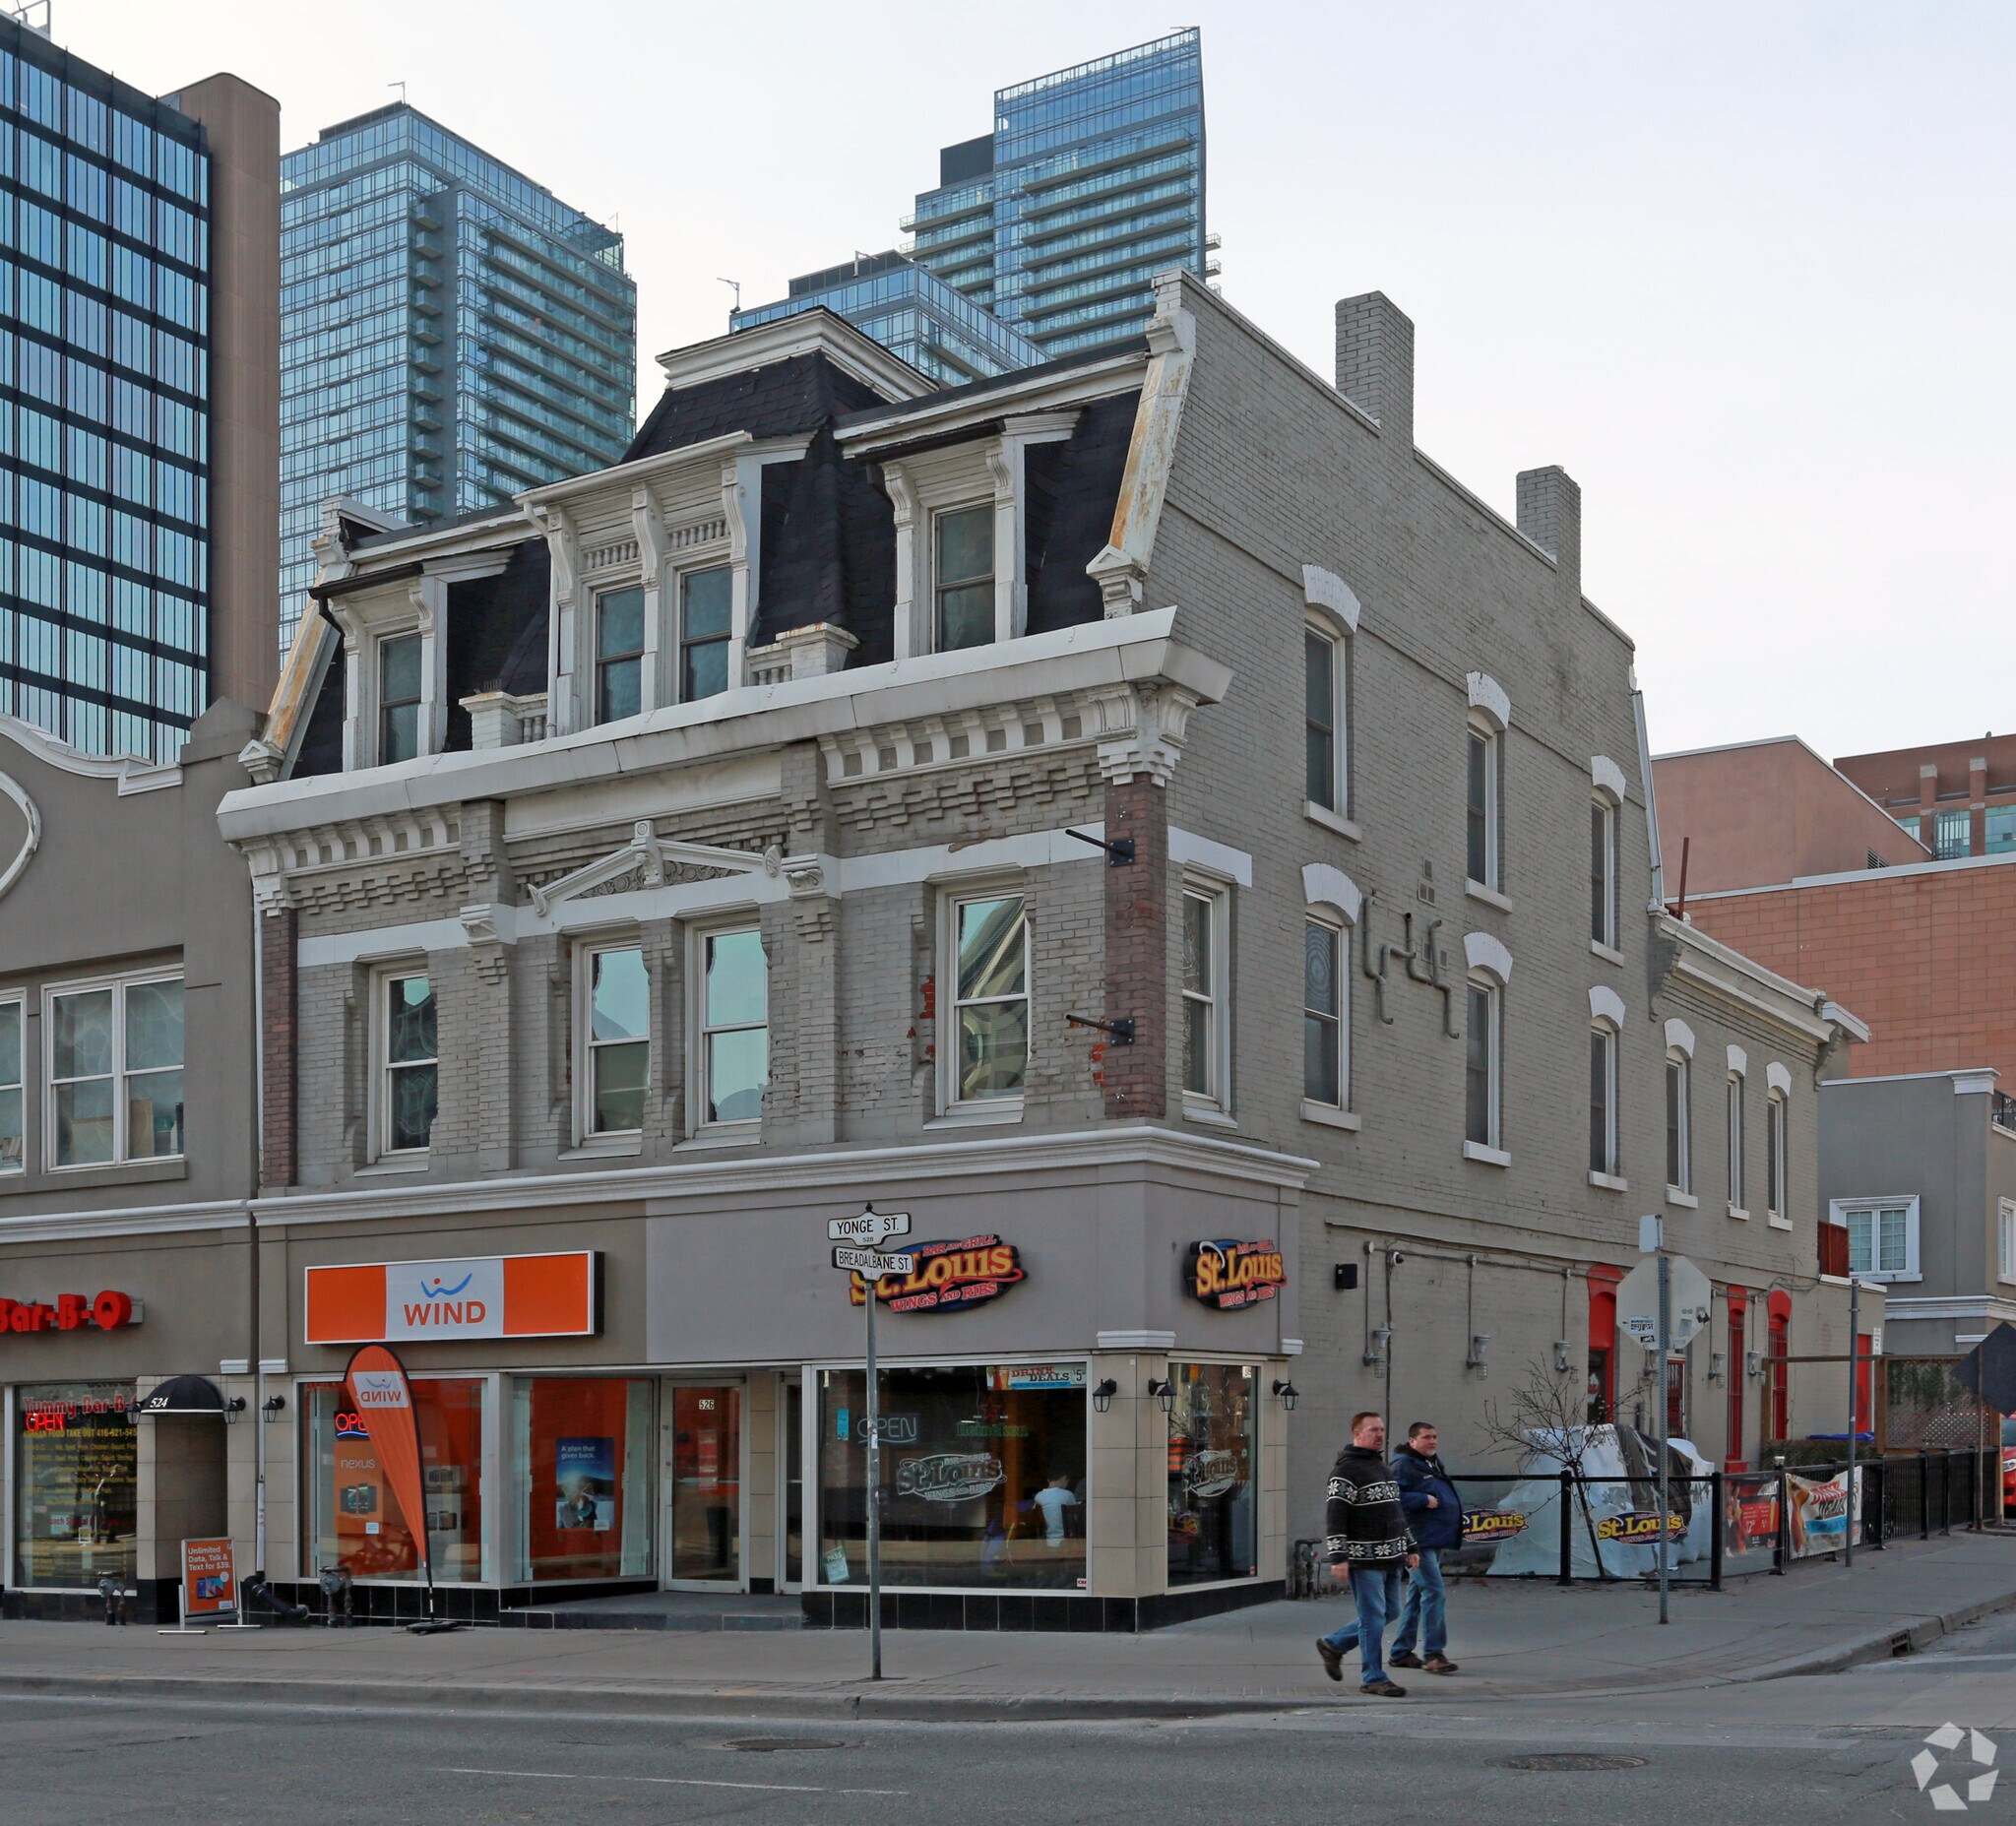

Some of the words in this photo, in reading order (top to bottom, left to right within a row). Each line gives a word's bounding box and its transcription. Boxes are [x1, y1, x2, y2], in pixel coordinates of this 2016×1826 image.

[837, 1220, 874, 1234] YONGE
[883, 1218, 899, 1231] ST.
[923, 1243, 947, 1256] BAR
[961, 1233, 997, 1249] GRILL
[839, 1250, 895, 1270] BREADALBANE
[898, 1258, 911, 1271] ST.
[889, 1291, 938, 1313] WINGS
[940, 1291, 961, 1302] AND
[962, 1282, 998, 1299] RIBS
[404, 1301, 486, 1326] WIND
[1011, 1366, 1054, 1377] DRINK
[1030, 1373, 1069, 1382] DEALS
[24, 1397, 77, 1419] Yummy
[150, 1398, 168, 1408] 524
[699, 1400, 714, 1410] 526
[26, 1413, 66, 1432] OPEN
[336, 1414, 367, 1431] OPE
[857, 1417, 916, 1438] OPEN
[341, 1459, 376, 1470] nexus
